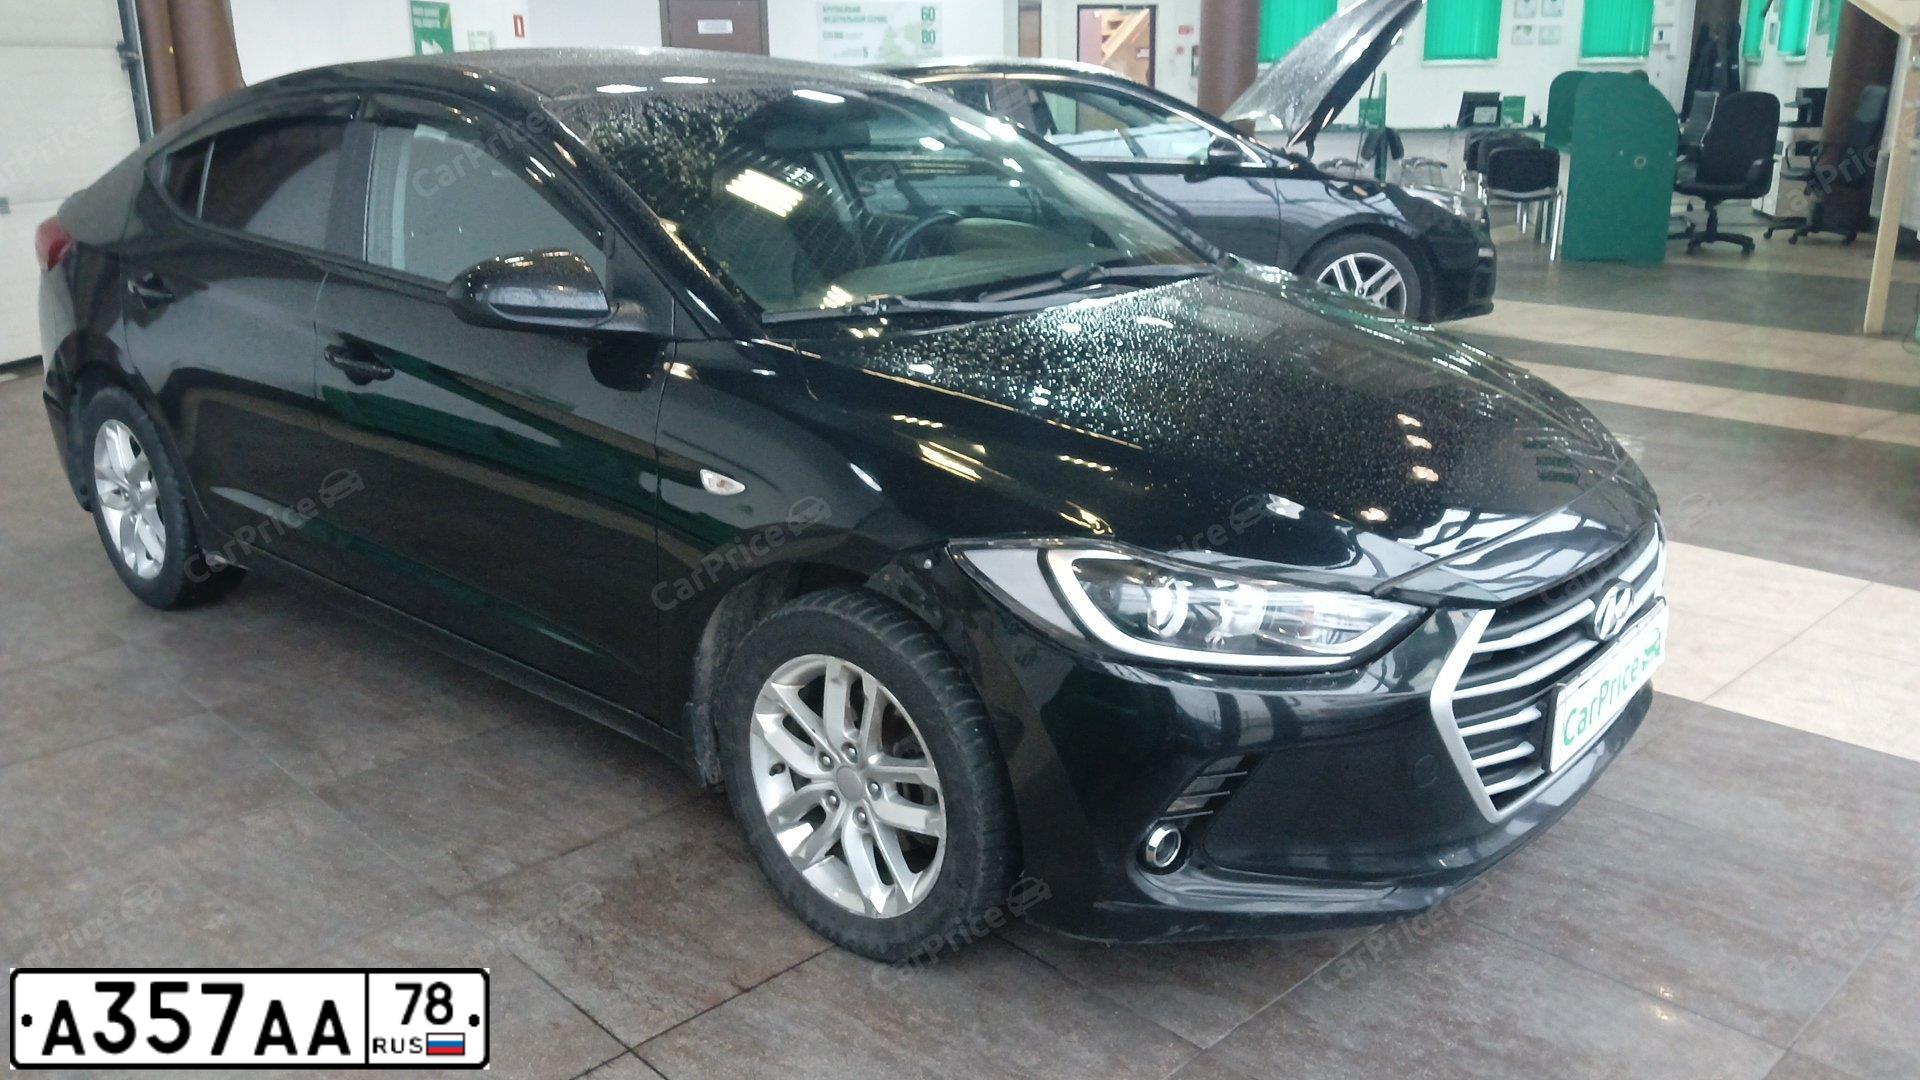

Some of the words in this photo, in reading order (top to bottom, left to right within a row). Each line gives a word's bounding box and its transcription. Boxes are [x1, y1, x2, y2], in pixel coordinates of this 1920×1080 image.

[920, 6, 936, 22] 60
[920, 29, 936, 45] 80
[1563, 657, 1639, 746] CarPrice
